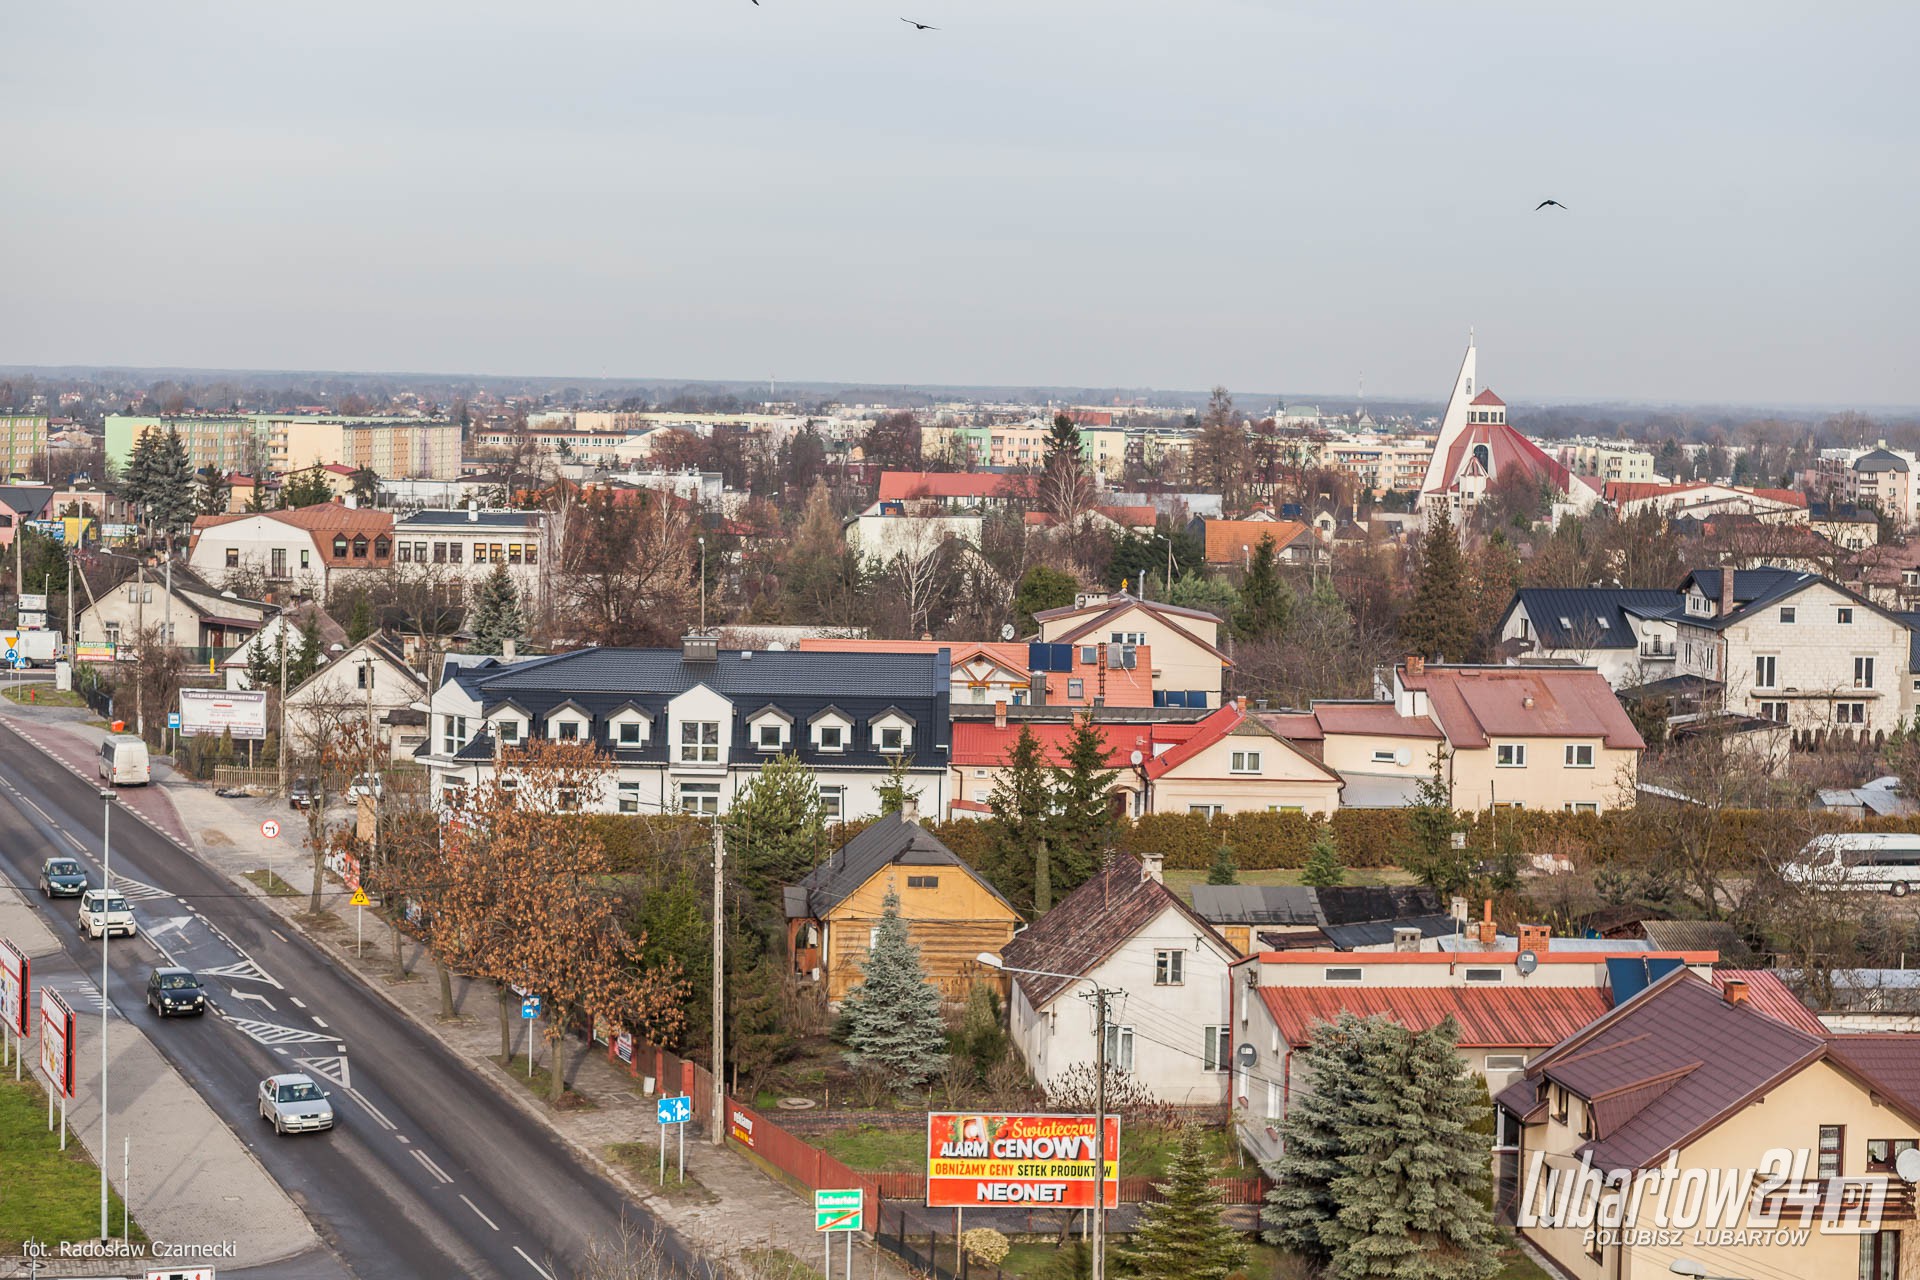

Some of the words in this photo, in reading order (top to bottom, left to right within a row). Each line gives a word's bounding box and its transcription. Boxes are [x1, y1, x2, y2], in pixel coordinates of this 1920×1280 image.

[1011, 1118, 1097, 1142] Świąteczny
[940, 1141, 988, 1158] ALARM
[993, 1135, 1098, 1160] CENOWY
[935, 1161, 986, 1175] OBNIŻAMY
[989, 1164, 1014, 1176] CENY
[1017, 1164, 1047, 1177] SETEK
[1050, 1164, 1112, 1177] PRODUKTW
[977, 1182, 1067, 1203] NEONET
